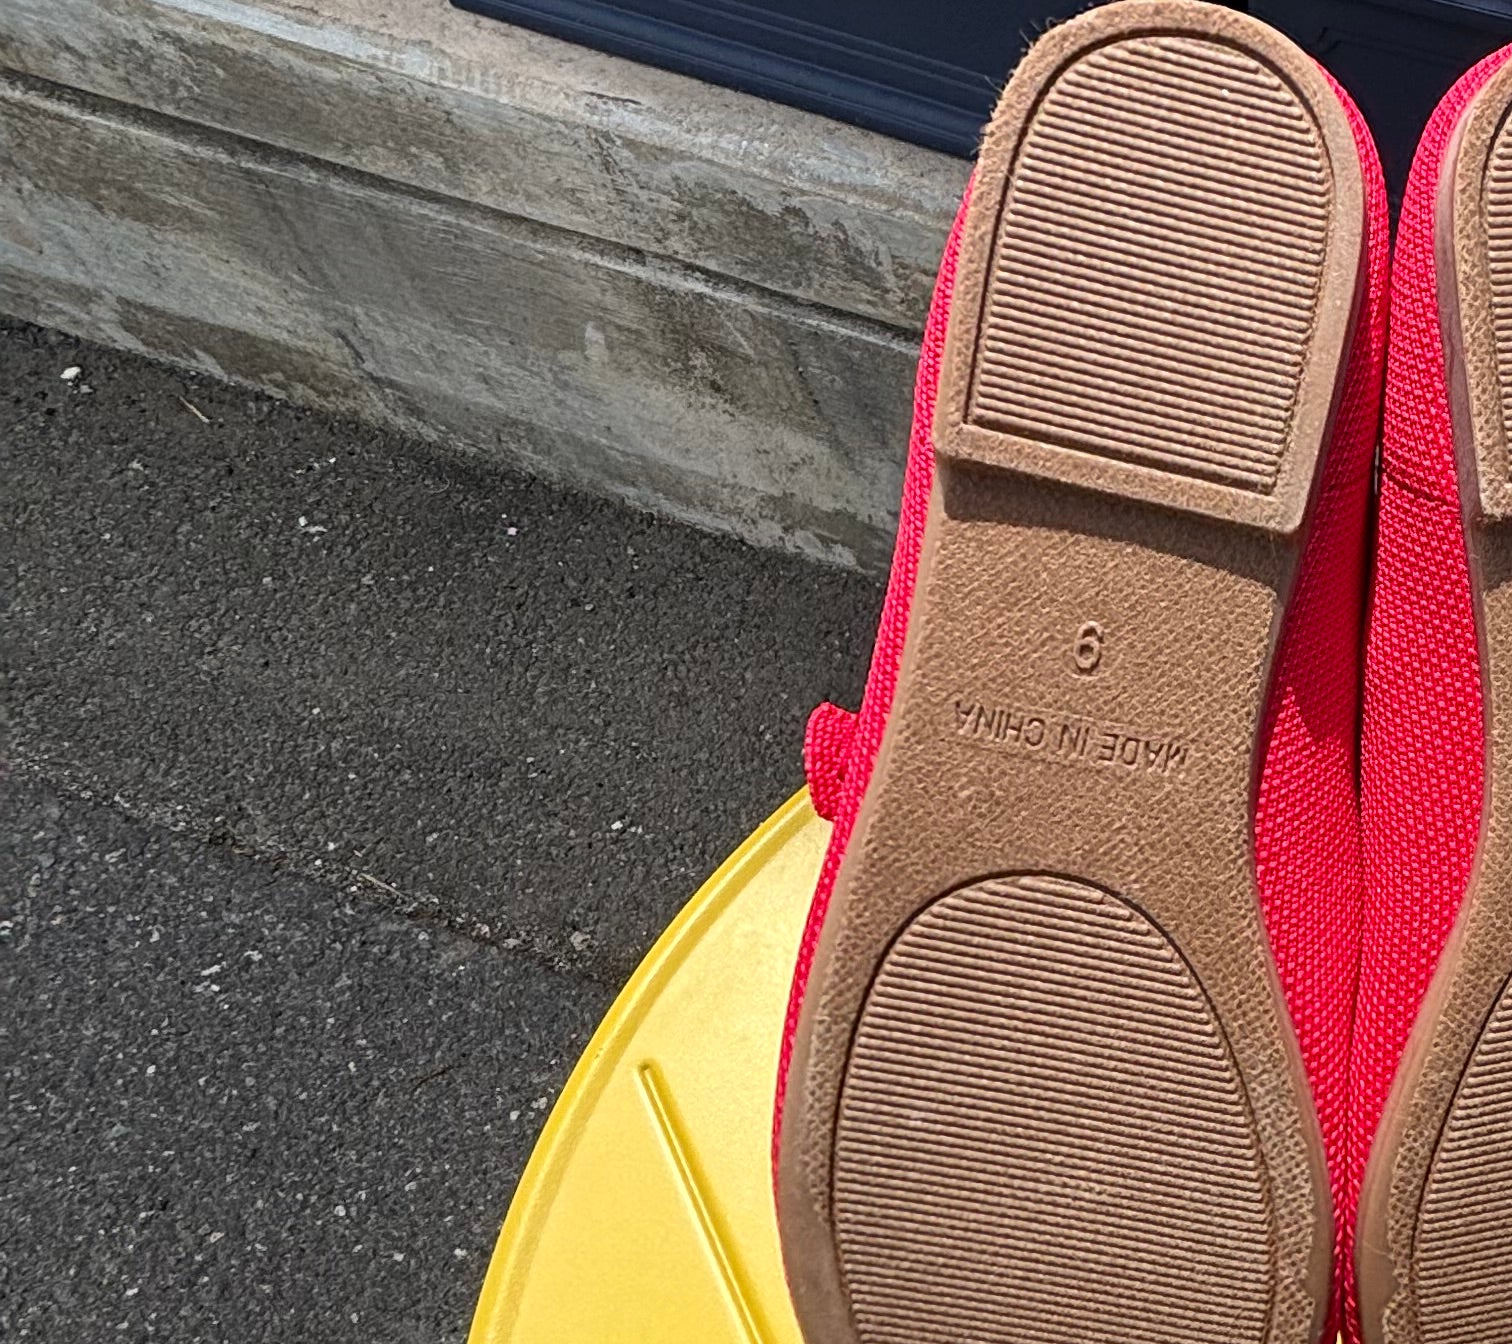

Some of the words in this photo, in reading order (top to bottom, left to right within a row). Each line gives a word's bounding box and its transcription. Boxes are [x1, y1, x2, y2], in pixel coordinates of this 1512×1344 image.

[1073, 620, 1105, 673] 9
[954, 700, 1046, 748] CHINA
[1058, 723, 1091, 756] IN
[1098, 732, 1188, 772] MADE
